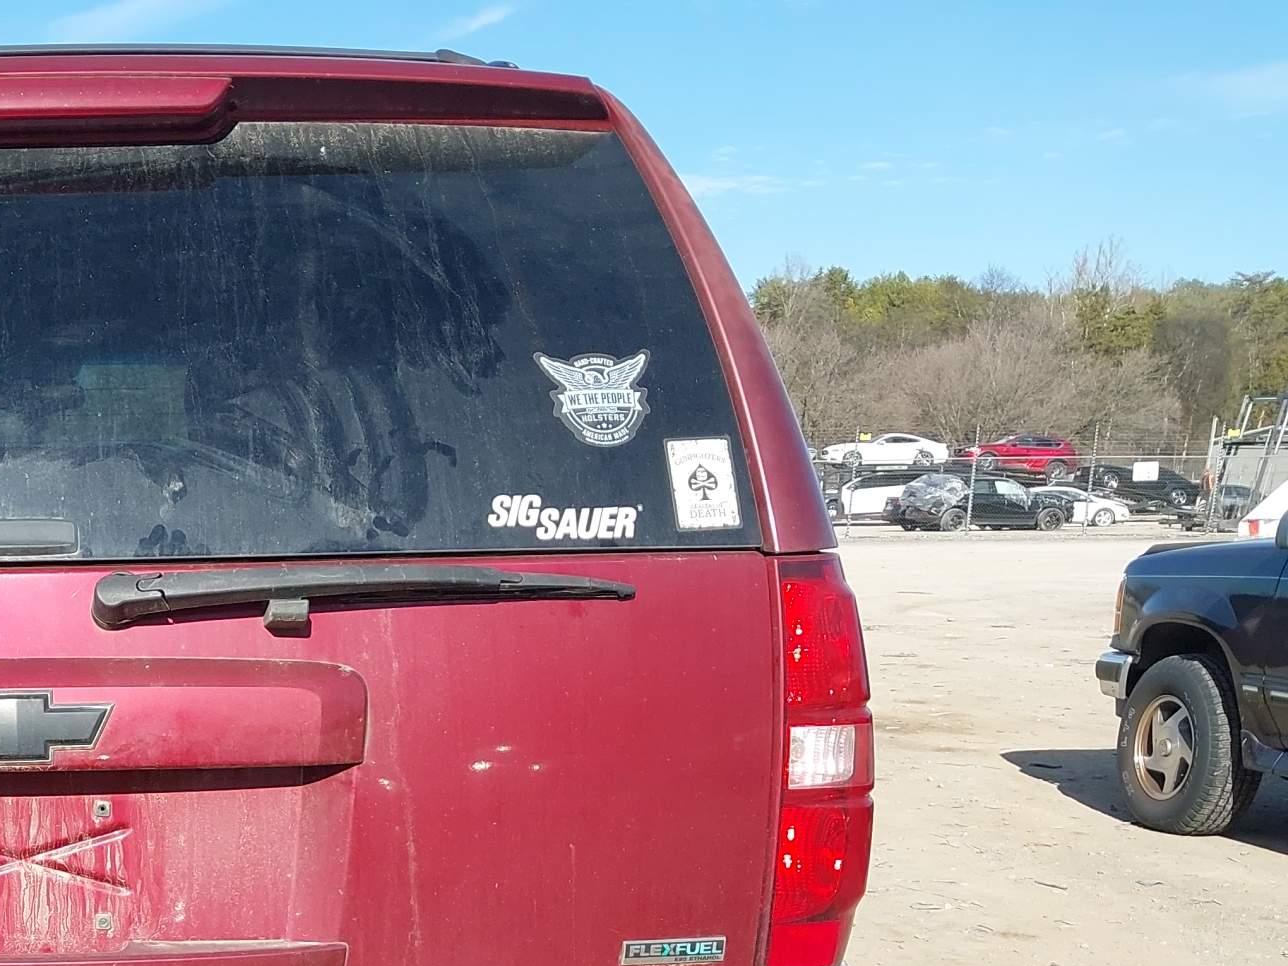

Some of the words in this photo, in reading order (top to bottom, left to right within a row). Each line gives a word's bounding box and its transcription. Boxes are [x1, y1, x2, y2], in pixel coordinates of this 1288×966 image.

[568, 393, 580, 405] WE
[583, 392, 599, 405] THE
[600, 391, 632, 404] PEOPLE
[581, 413, 625, 422] HOLSTERS
[582, 428, 612, 441] AMERICAN
[612, 426, 630, 440] MADE
[487, 494, 542, 527] SIG
[536, 505, 639, 540] SAUER
[690, 508, 727, 519] DEATH
[629, 942, 722, 957] FLEXFUEL
